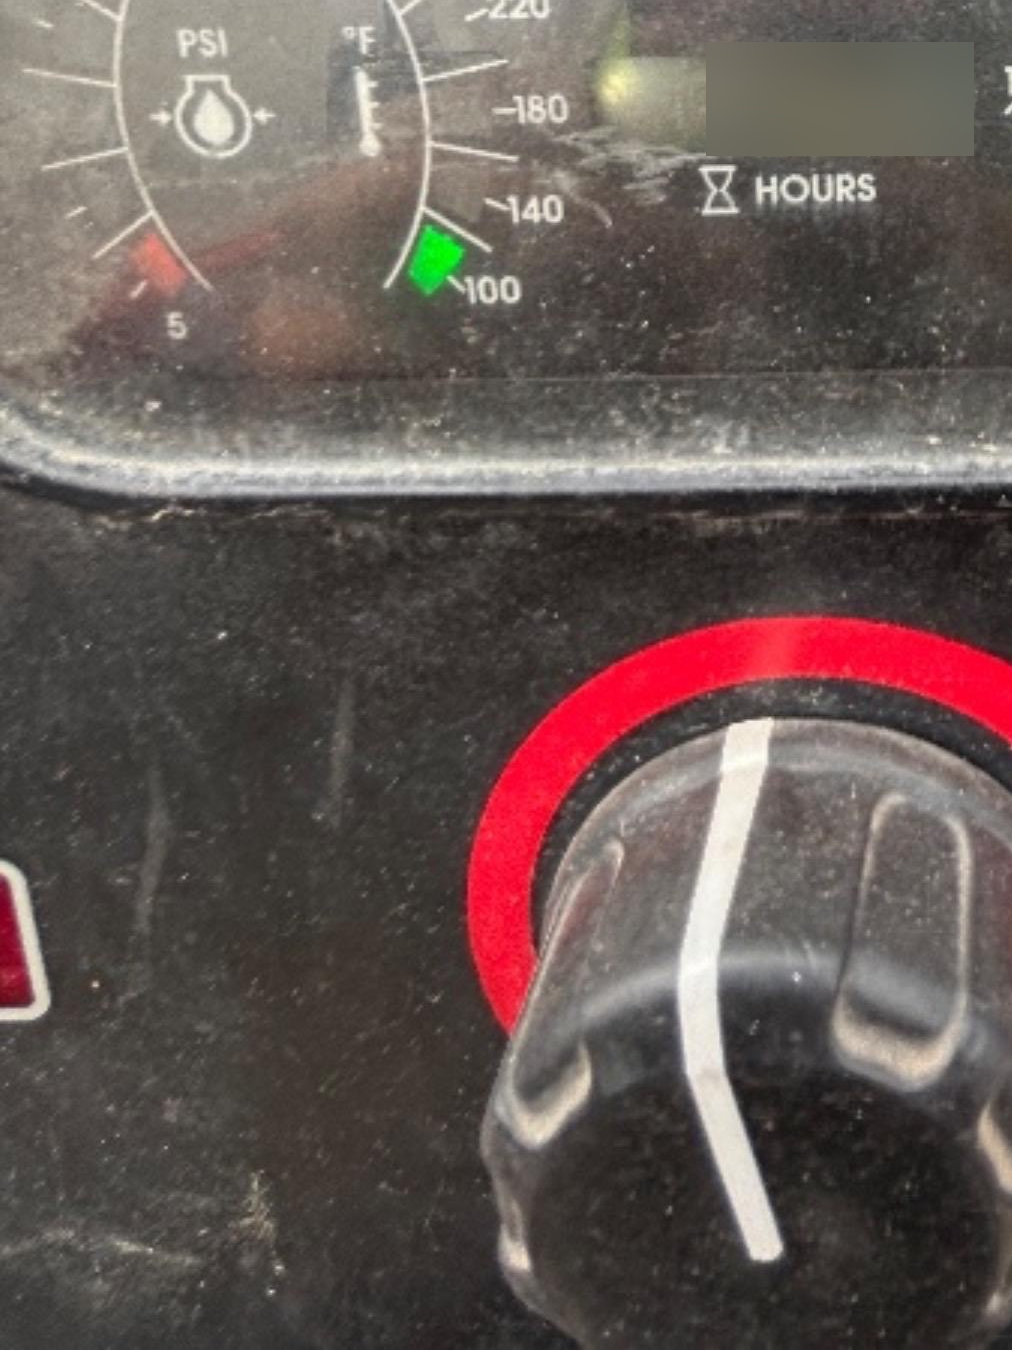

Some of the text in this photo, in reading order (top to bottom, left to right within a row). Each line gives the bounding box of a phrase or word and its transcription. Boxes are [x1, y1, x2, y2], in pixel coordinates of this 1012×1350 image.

[178, 29, 228, 58] PSI
[514, 94, 569, 124] 180
[754, 173, 877, 205] HOURS
[508, 194, 564, 223] 140
[463, 275, 521, 303] 100
[166, 312, 189, 340] 5
